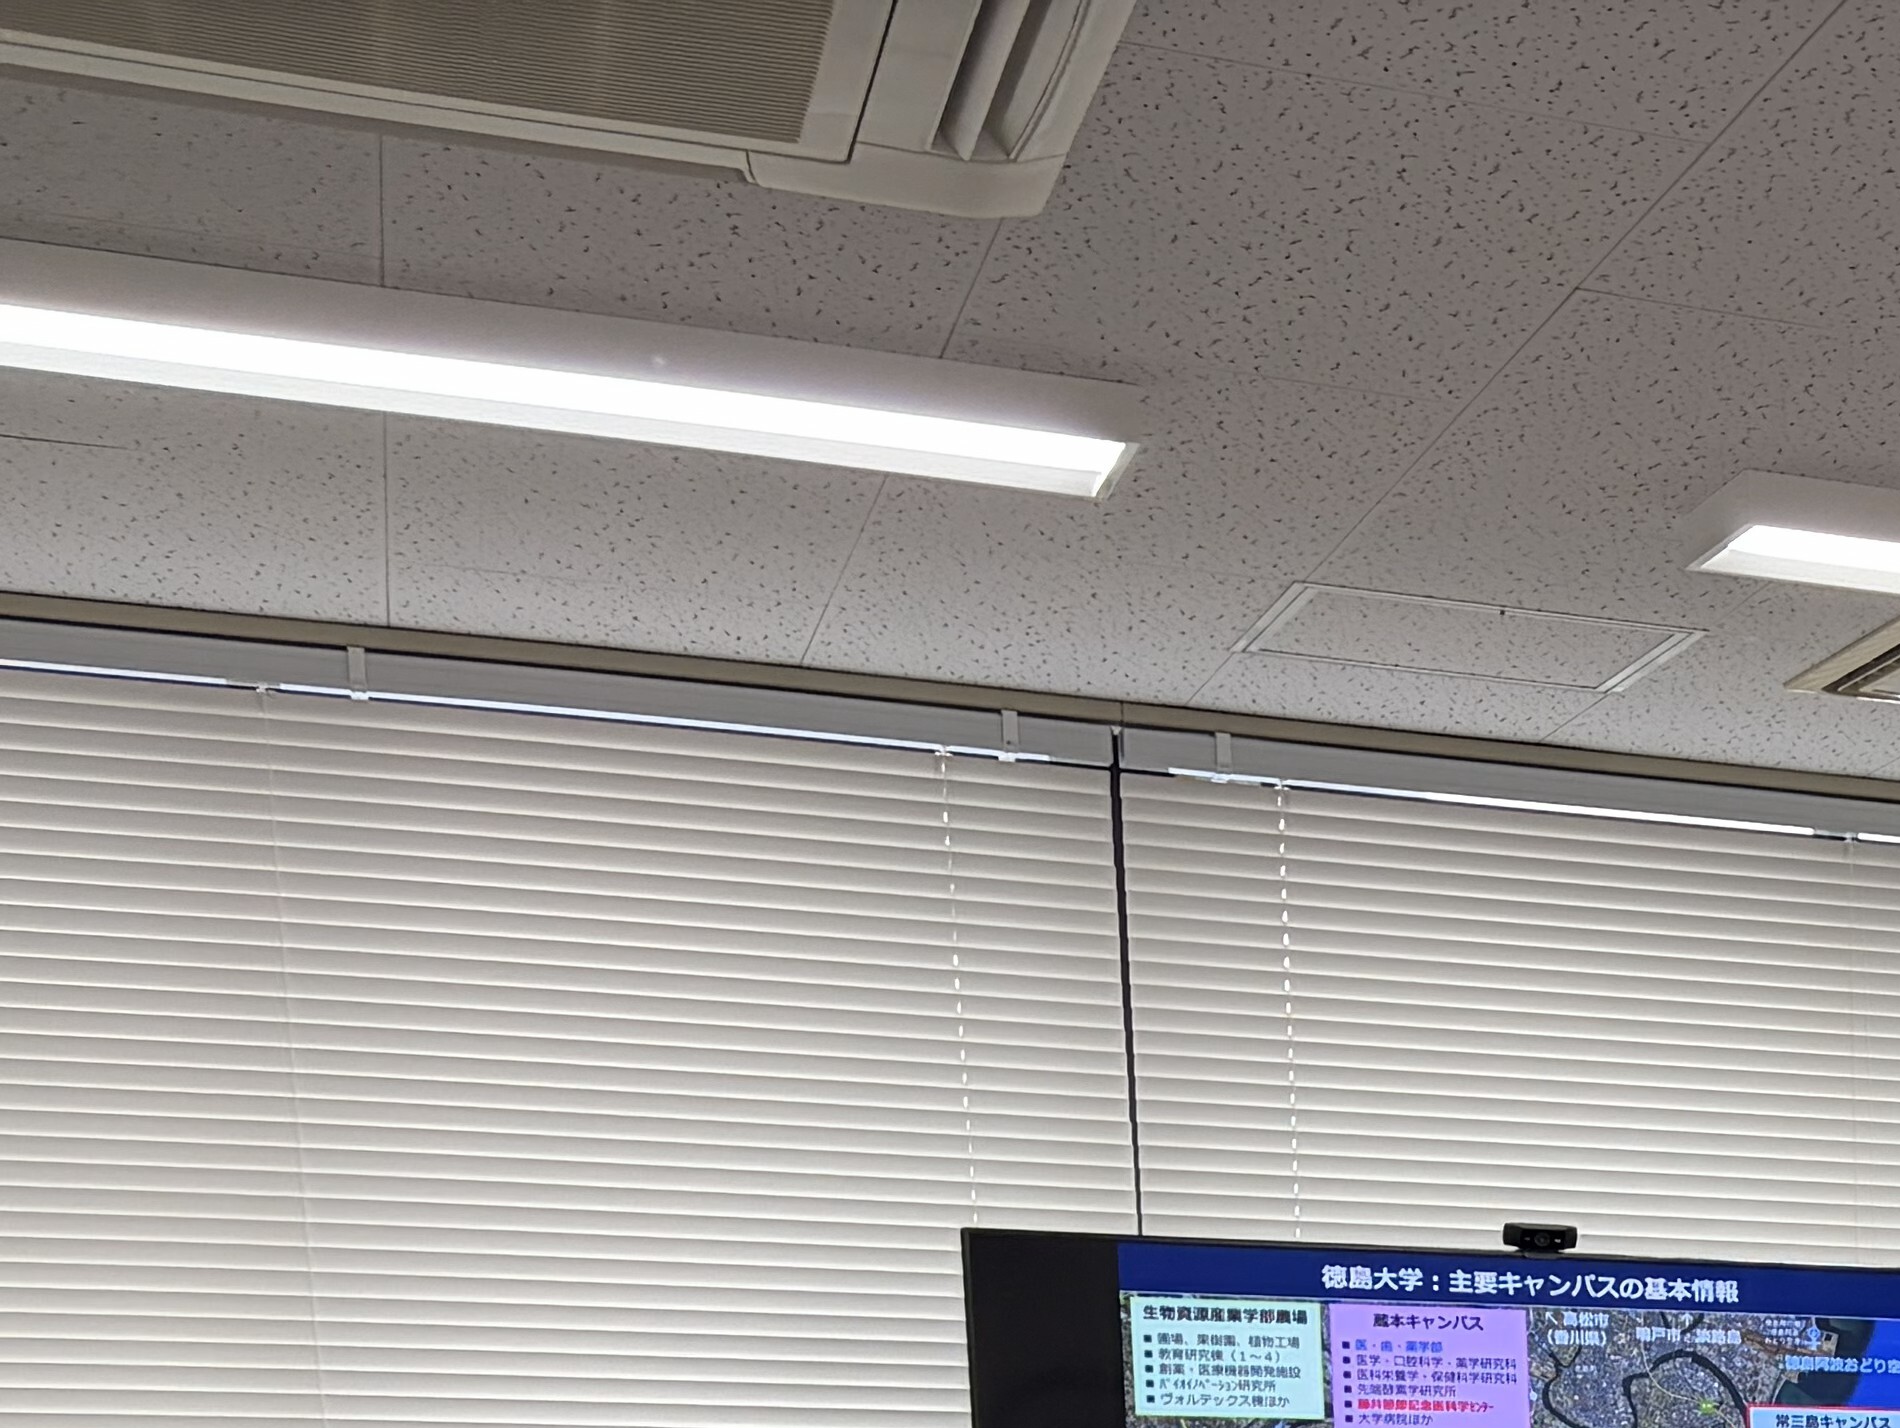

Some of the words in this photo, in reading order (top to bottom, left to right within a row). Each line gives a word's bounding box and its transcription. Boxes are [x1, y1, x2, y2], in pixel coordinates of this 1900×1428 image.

[1321, 1264, 1739, 1303] 徳島大学：主要キャンパスの基本情報
[1373, 1314, 1484, 1331] 蔵本キャンパス
